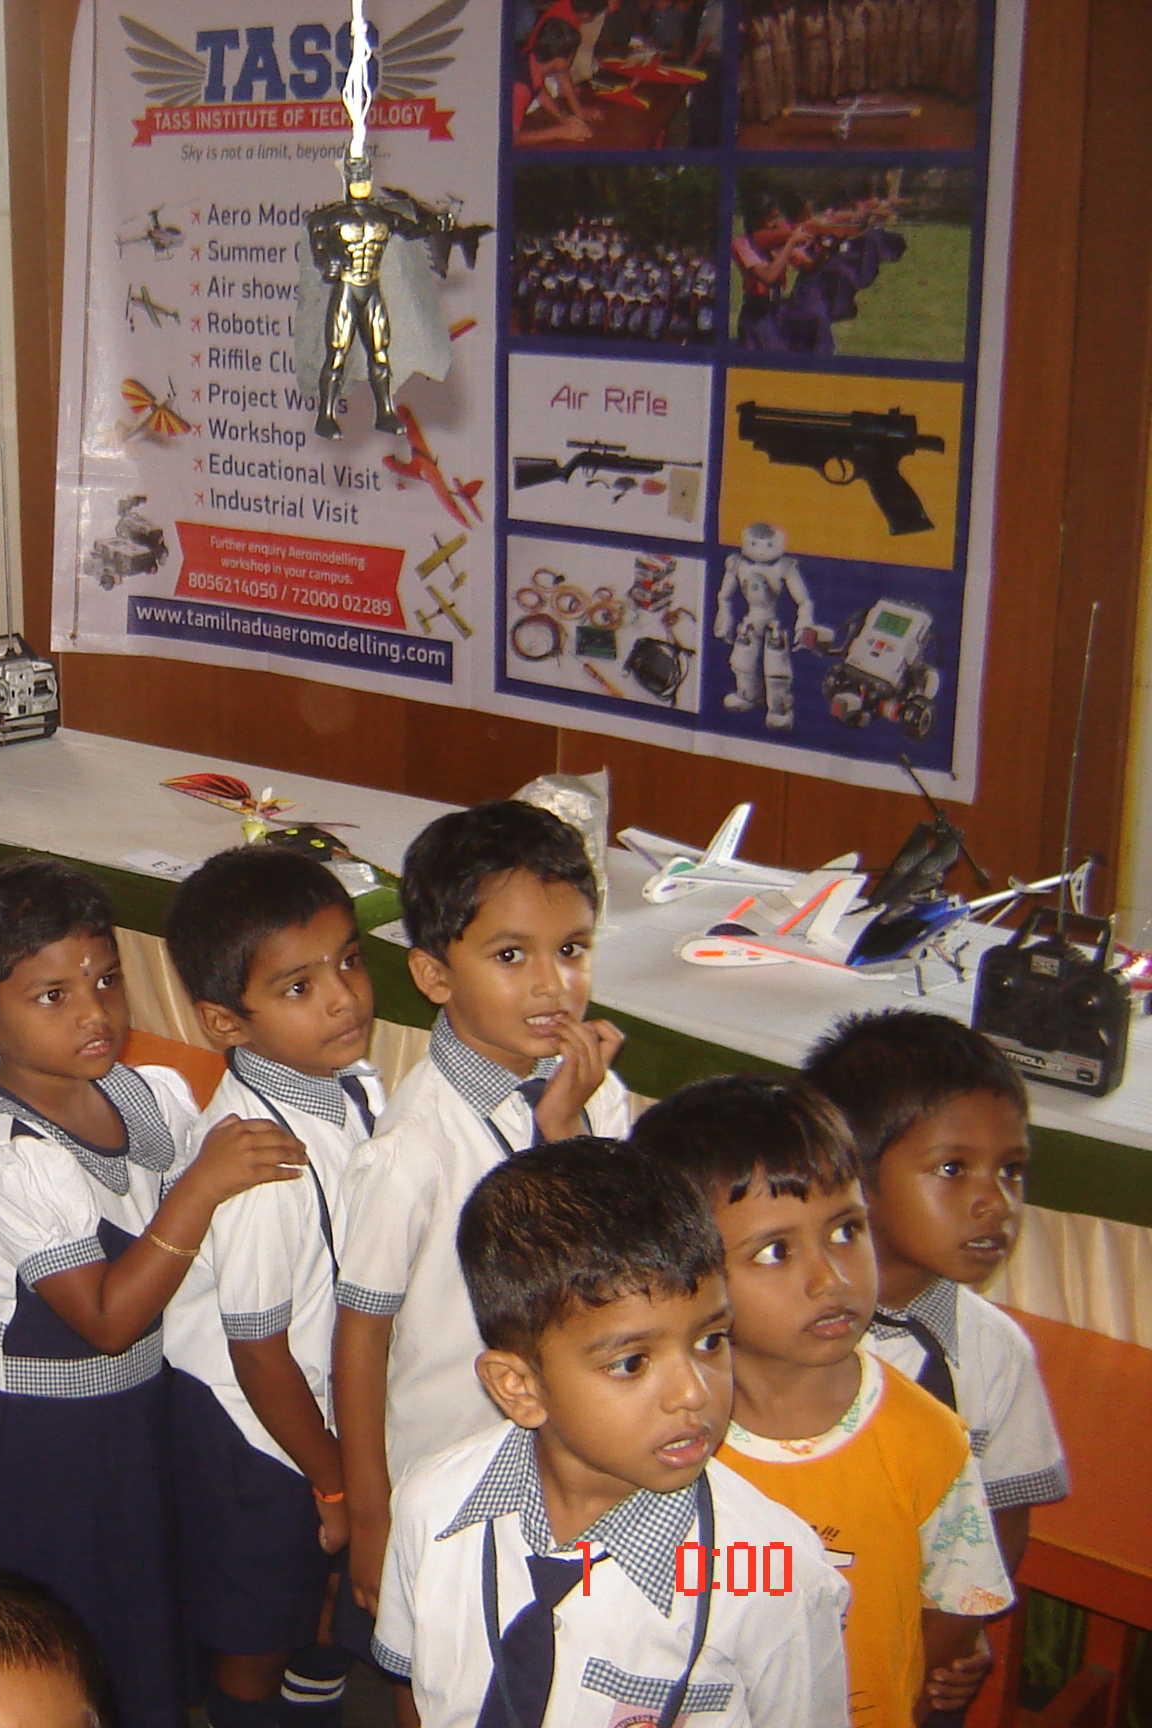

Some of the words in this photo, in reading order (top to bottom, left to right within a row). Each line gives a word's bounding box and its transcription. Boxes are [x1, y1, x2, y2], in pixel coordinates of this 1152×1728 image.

[196, 20, 379, 103] TASS
[154, 111, 191, 131] TASS
[196, 109, 278, 130] INSTITUTE
[283, 109, 304, 127] OF
[311, 105, 425, 127] TECHOLOGY
[181, 144, 203, 163] Sky
[206, 144, 217, 160] is
[220, 145, 243, 160] not
[246, 149, 254, 159] a
[257, 143, 292, 161] limit,
[207, 203, 251, 226] Aero
[208, 240, 288, 264] Summer
[207, 276, 239, 299] Air
[242, 276, 299, 300] shows
[207, 312, 281, 336] Robotic
[208, 347, 262, 372] Riffile
[270, 351, 296, 374] Clu
[208, 383, 278, 412] Project
[284, 388, 348, 414] Wos
[551, 385, 589, 410] Air
[605, 388, 667, 417] Rifle
[208, 418, 306, 452] Workshop
[209, 453, 326, 486] Educational
[333, 464, 381, 491] Visit
[210, 488, 305, 519] Industrial
[313, 498, 359, 526] Visit
[210, 536, 247, 552] Further
[248, 542, 286, 560] enquiry
[289, 546, 366, 572] Aeromodelling
[221, 556, 270, 576] workshop
[272, 561, 281, 574] in
[283, 565, 307, 581] your
[309, 568, 353, 586] campus.
[188, 572, 278, 600] 8056214050
[291, 586, 339, 610] 72000
[342, 594, 392, 617] 02289
[136, 604, 446, 666] www.tamilnaduaeromodelling.com
